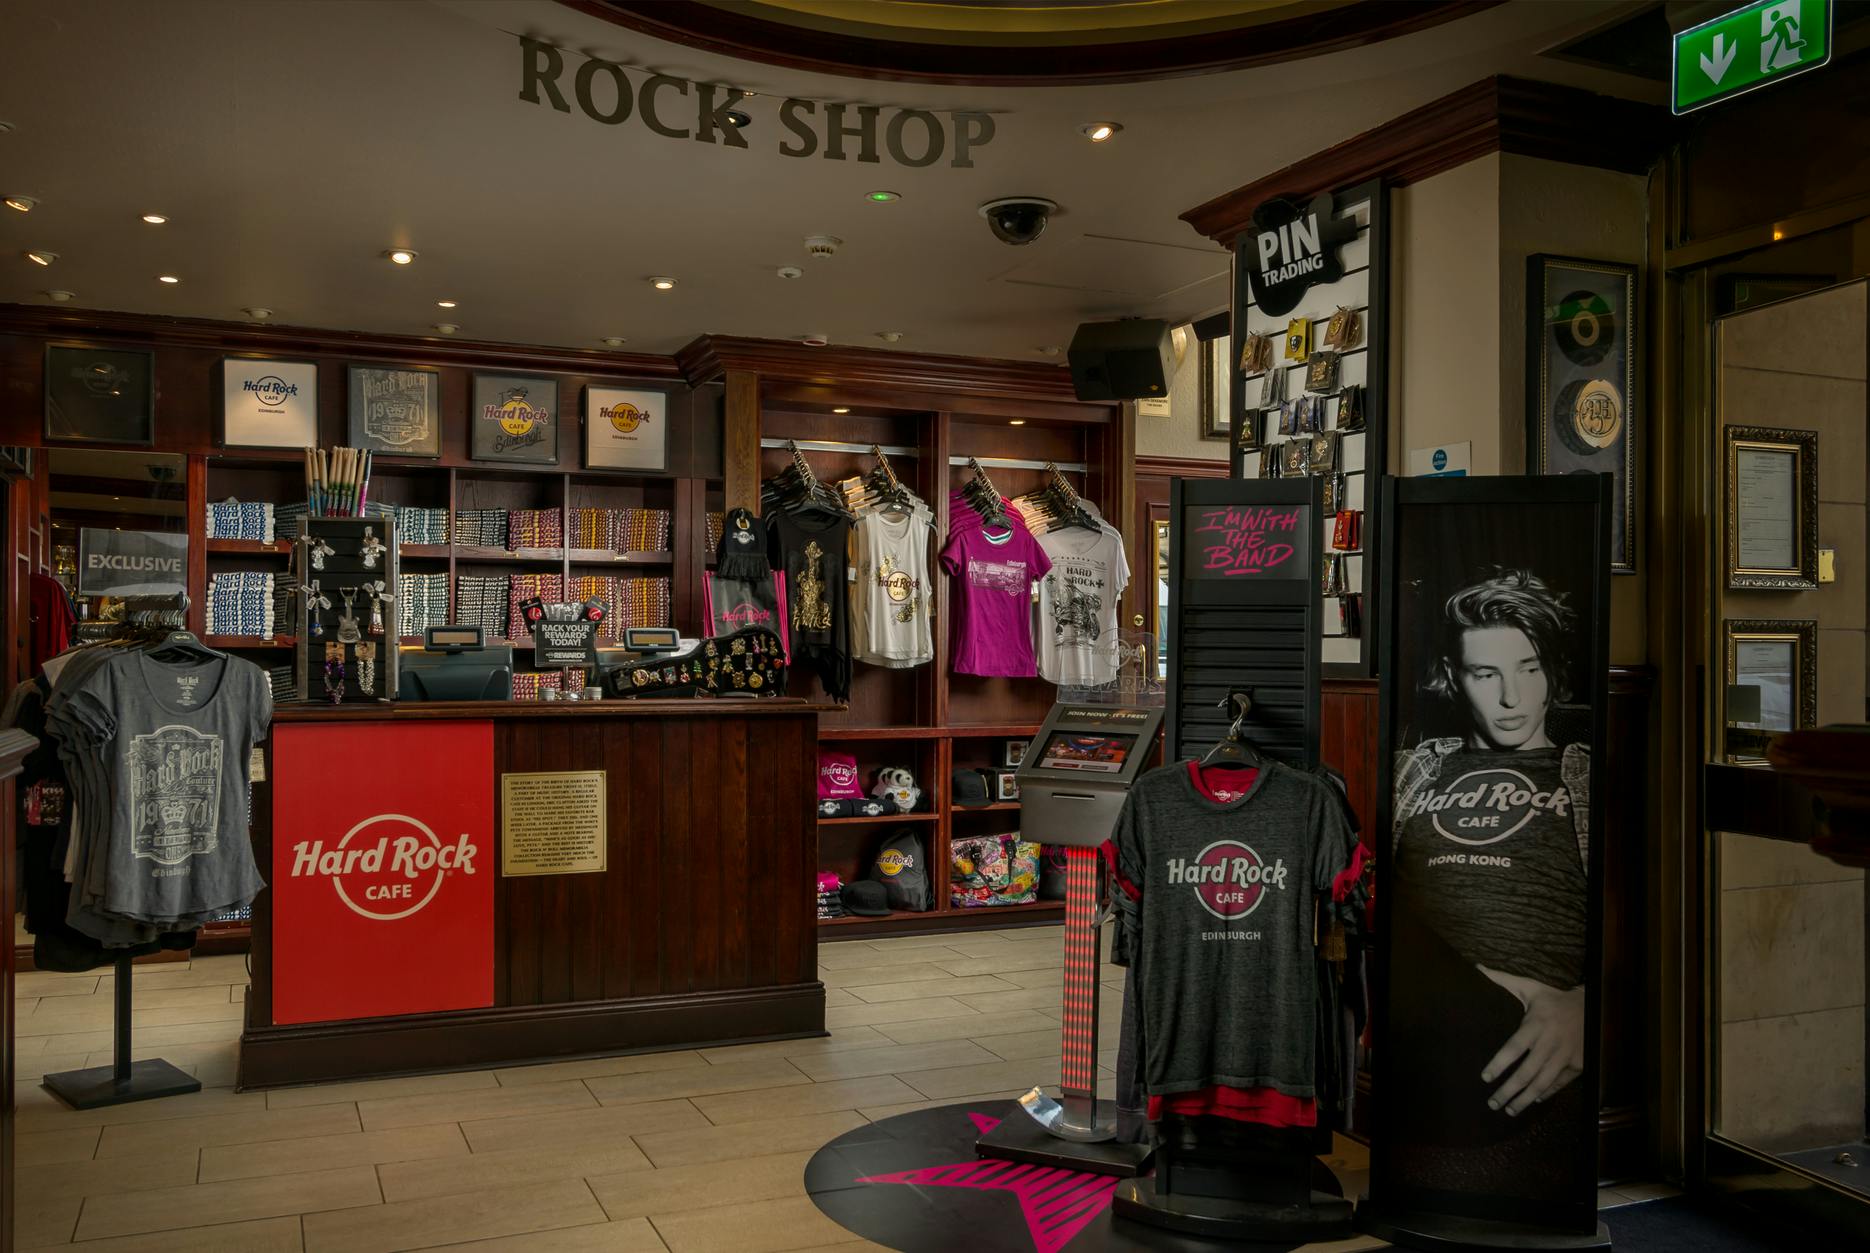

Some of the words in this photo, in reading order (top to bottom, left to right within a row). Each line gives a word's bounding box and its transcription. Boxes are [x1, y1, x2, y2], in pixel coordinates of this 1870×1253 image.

[519, 36, 748, 149] ROCK
[778, 97, 996, 168] SHOP
[1257, 212, 1321, 272] PIN
[1261, 253, 1324, 288] TRADING
[243, 380, 272, 392] Hard
[272, 382, 298, 396] Rock
[484, 404, 517, 420] Hard
[517, 406, 549, 425] Rock
[599, 406, 626, 419] Hard
[626, 409, 650, 423] Rock
[1221, 529, 1266, 550] THE
[88, 554, 182, 573] EXCLUSIVE
[1203, 543, 1295, 570] BAND
[1066, 567, 1092, 577] HARD
[878, 576, 899, 588] Hard
[899, 577, 920, 590] Rock
[1070, 576, 1096, 588] ROCK
[542, 624, 565, 632] RACK
[565, 624, 590, 633] YOUR
[544, 631, 588, 640] REWARDS
[551, 639, 582, 647] TODAY!
[1408, 783, 1489, 818] Hard
[1485, 782, 1571, 817] Rock
[1457, 816, 1500, 828] CAFE
[291, 837, 389, 877] Hard
[391, 833, 478, 879] Rock
[893, 853, 914, 868] Rock
[1428, 854, 1466, 868] HONG
[1469, 854, 1512, 868] KONG
[1167, 858, 1229, 885] Hard
[1230, 857, 1289, 889] Rock
[365, 884, 413, 900] CAFE
[1215, 892, 1245, 904] CAFE
[1201, 931, 1262, 941] EDINBURGH
